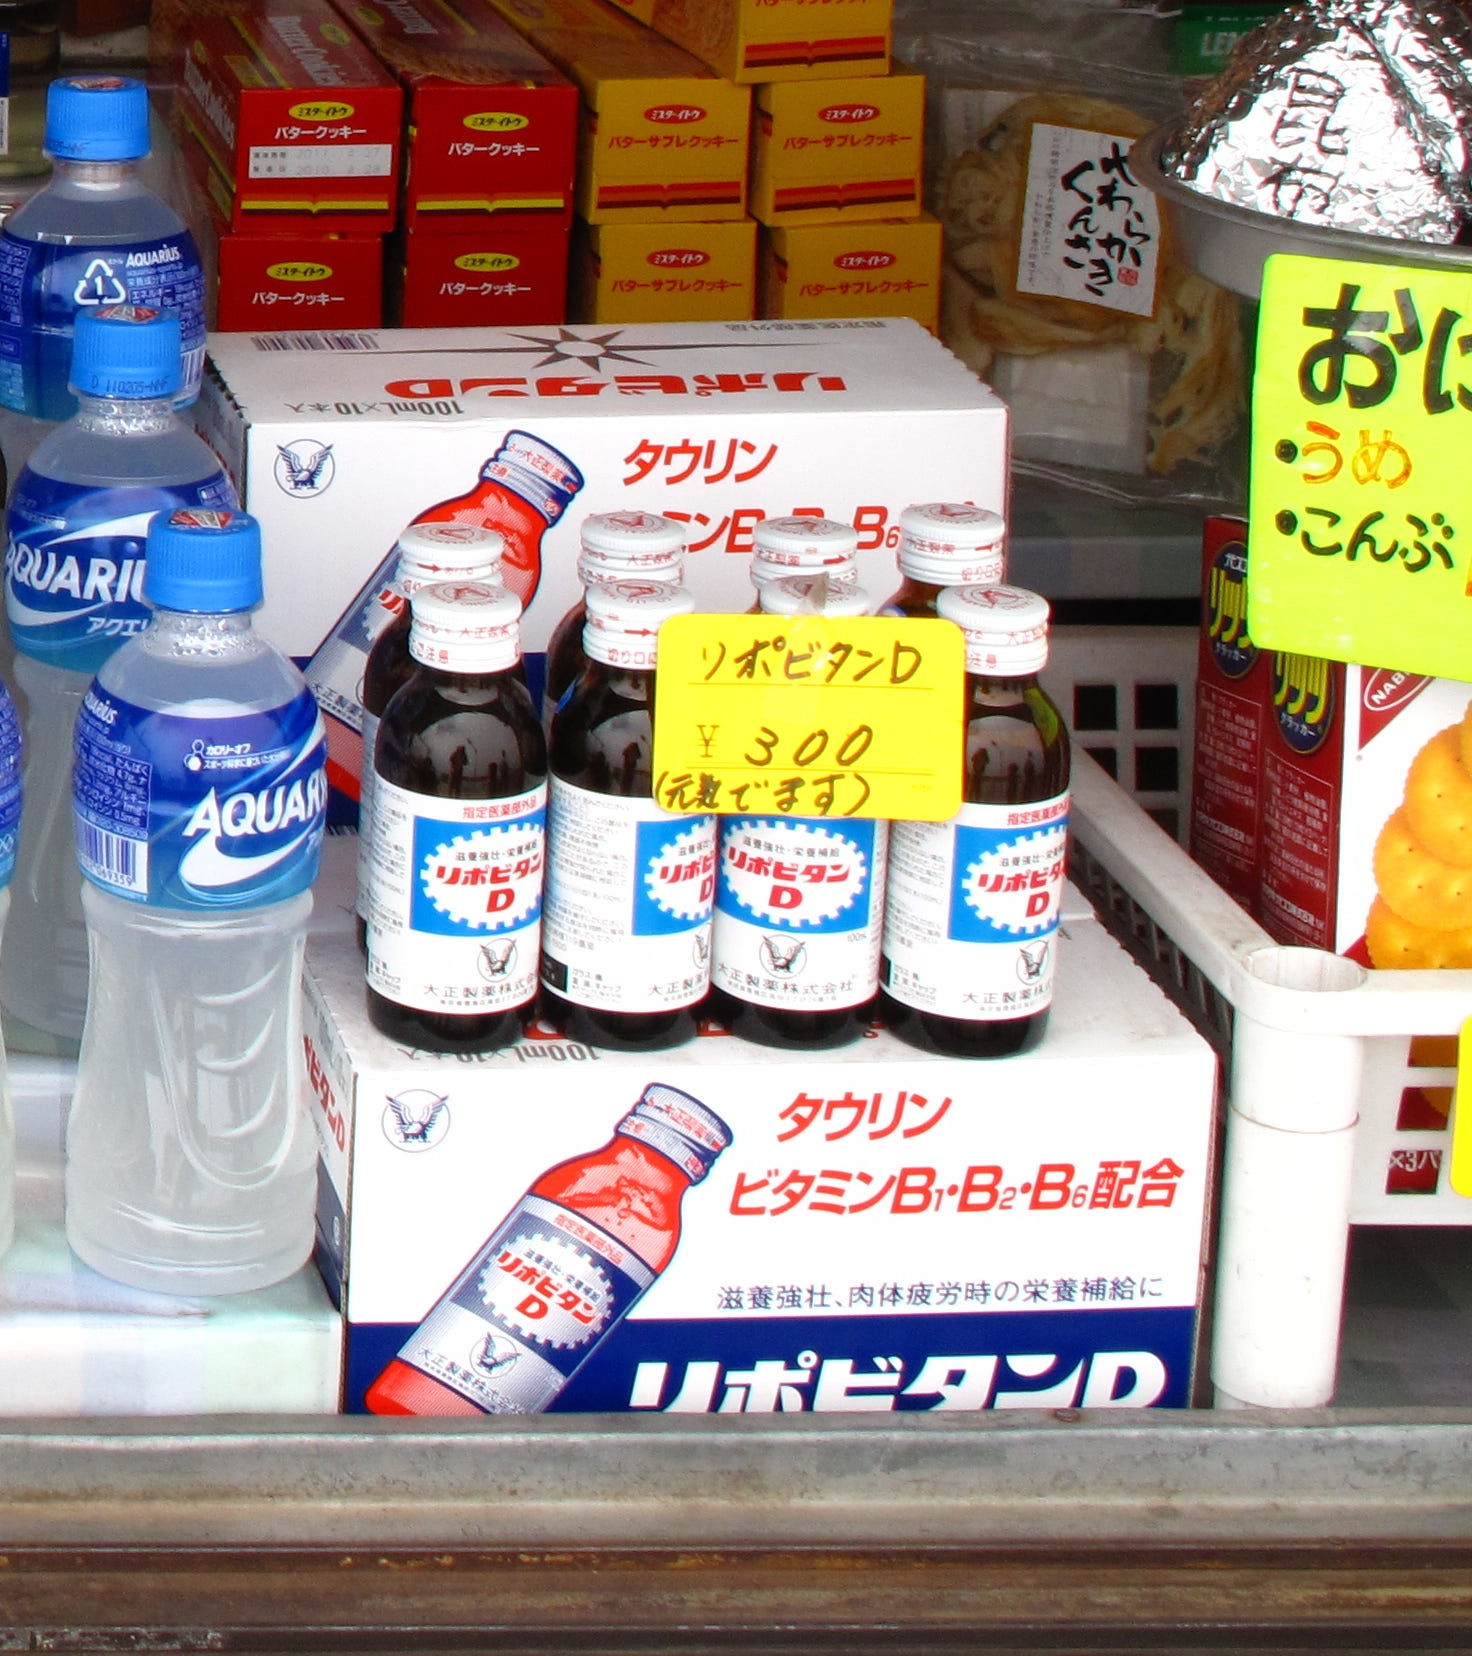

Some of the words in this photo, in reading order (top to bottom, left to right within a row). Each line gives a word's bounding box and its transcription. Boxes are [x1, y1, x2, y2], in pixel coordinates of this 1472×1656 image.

[274, 125, 367, 140] バタークッキー
[609, 134, 739, 149] バターサブレクッキー
[783, 132, 913, 150] バターサブレクッキー
[447, 143, 540, 156] バタークッキー
[622, 438, 779, 486] タウリン
[1302, 421, 1412, 490] うめ
[1301, 506, 1454, 573] こんぶ
[699, 639, 923, 682] リポビタンD
[435, 854, 544, 886] リポビタン
[727, 846, 851, 883] リポビタン
[485, 887, 515, 913] D
[768, 886, 803, 909] D
[776, 1091, 954, 1142] タウリン
